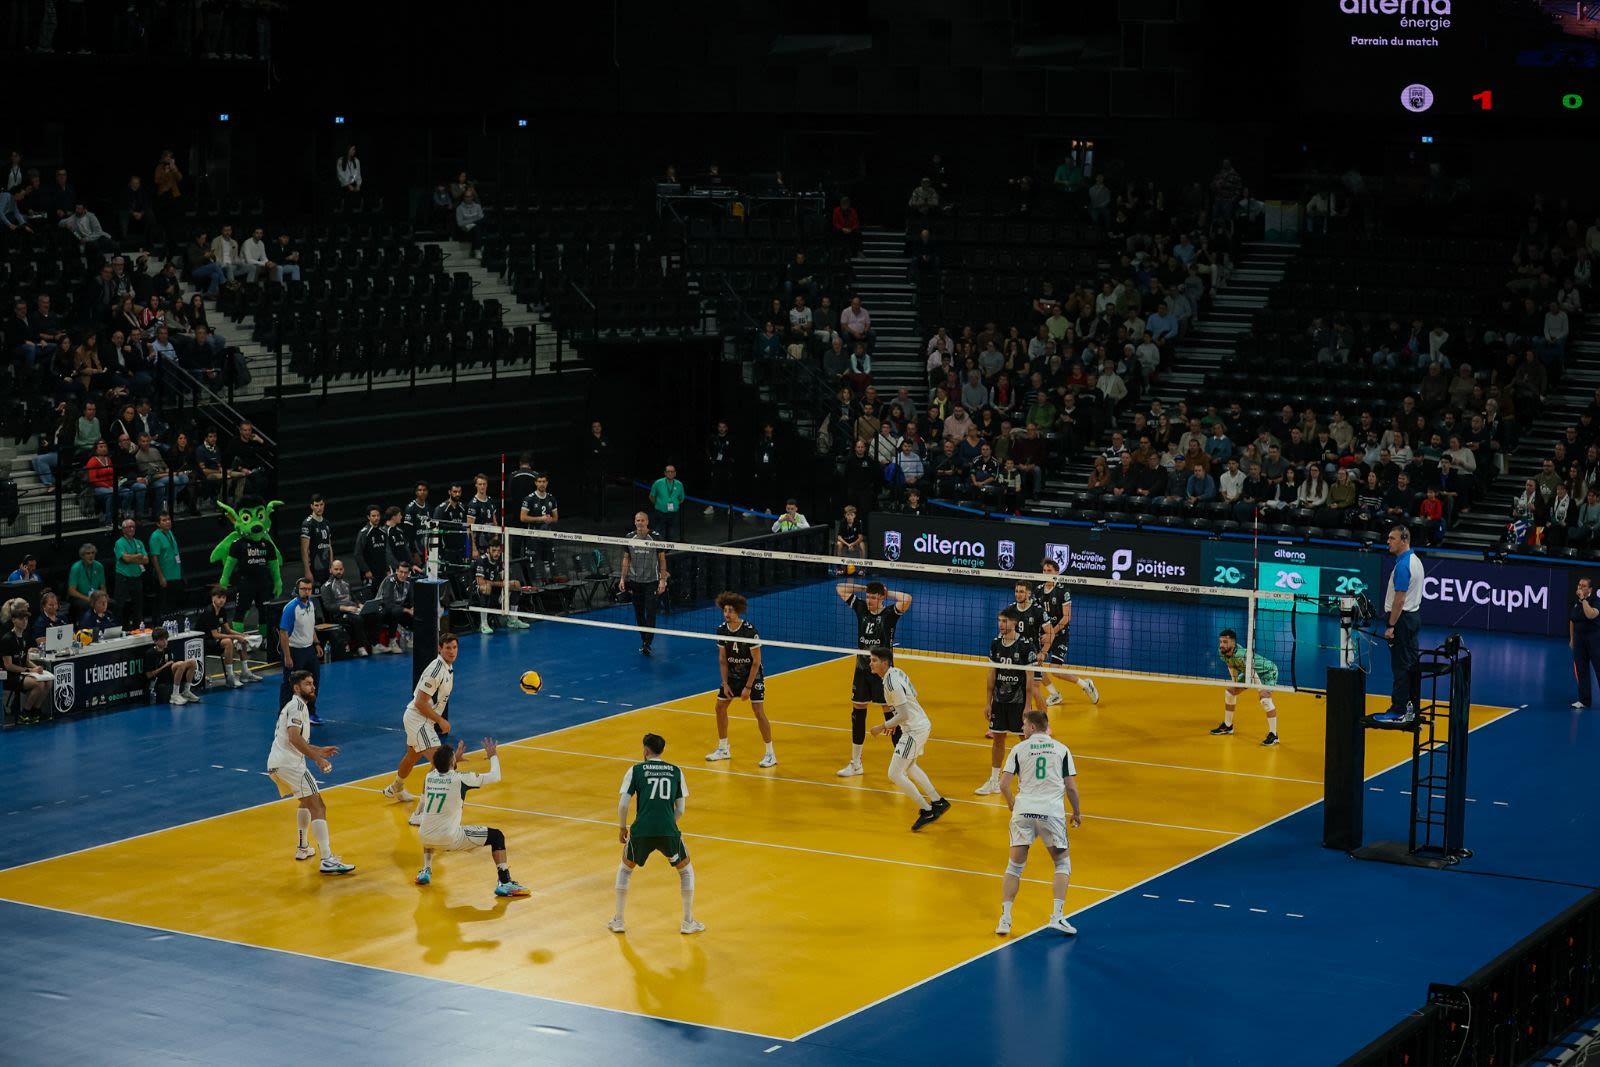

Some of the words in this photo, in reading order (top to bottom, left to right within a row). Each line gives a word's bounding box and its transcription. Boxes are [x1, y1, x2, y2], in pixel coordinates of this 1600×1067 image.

[1400, 16, 1451, 31] énergie
[1351, 36, 1388, 46] Parrain
[1391, 37, 1403, 46] du
[1406, 37, 1438, 47] match
[1472, 90, 1493, 110] 1
[1562, 93, 1583, 109] 0
[914, 533, 985, 557] alterna
[1071, 552, 1107, 563] Nouvelle-
[1274, 549, 1306, 560] alterna
[952, 556, 984, 568] énergie
[1071, 560, 1106, 571] Aquitaine
[1136, 560, 1185, 578] poitiers
[1274, 570, 1303, 590] 20
[1422, 576, 1549, 613] CEVCupM
[1043, 601, 1050, 612] 11
[865, 622, 875, 635] 12
[1018, 620, 1025, 632] 9
[732, 641, 739, 653] 4
[56, 672, 72, 684] SPVB
[85, 660, 128, 685] L'ÉNERGIE
[997, 673, 1019, 682] lterna
[1035, 756, 1046, 780] 8
[647, 777, 671, 800] 70
[427, 792, 447, 813] 77
